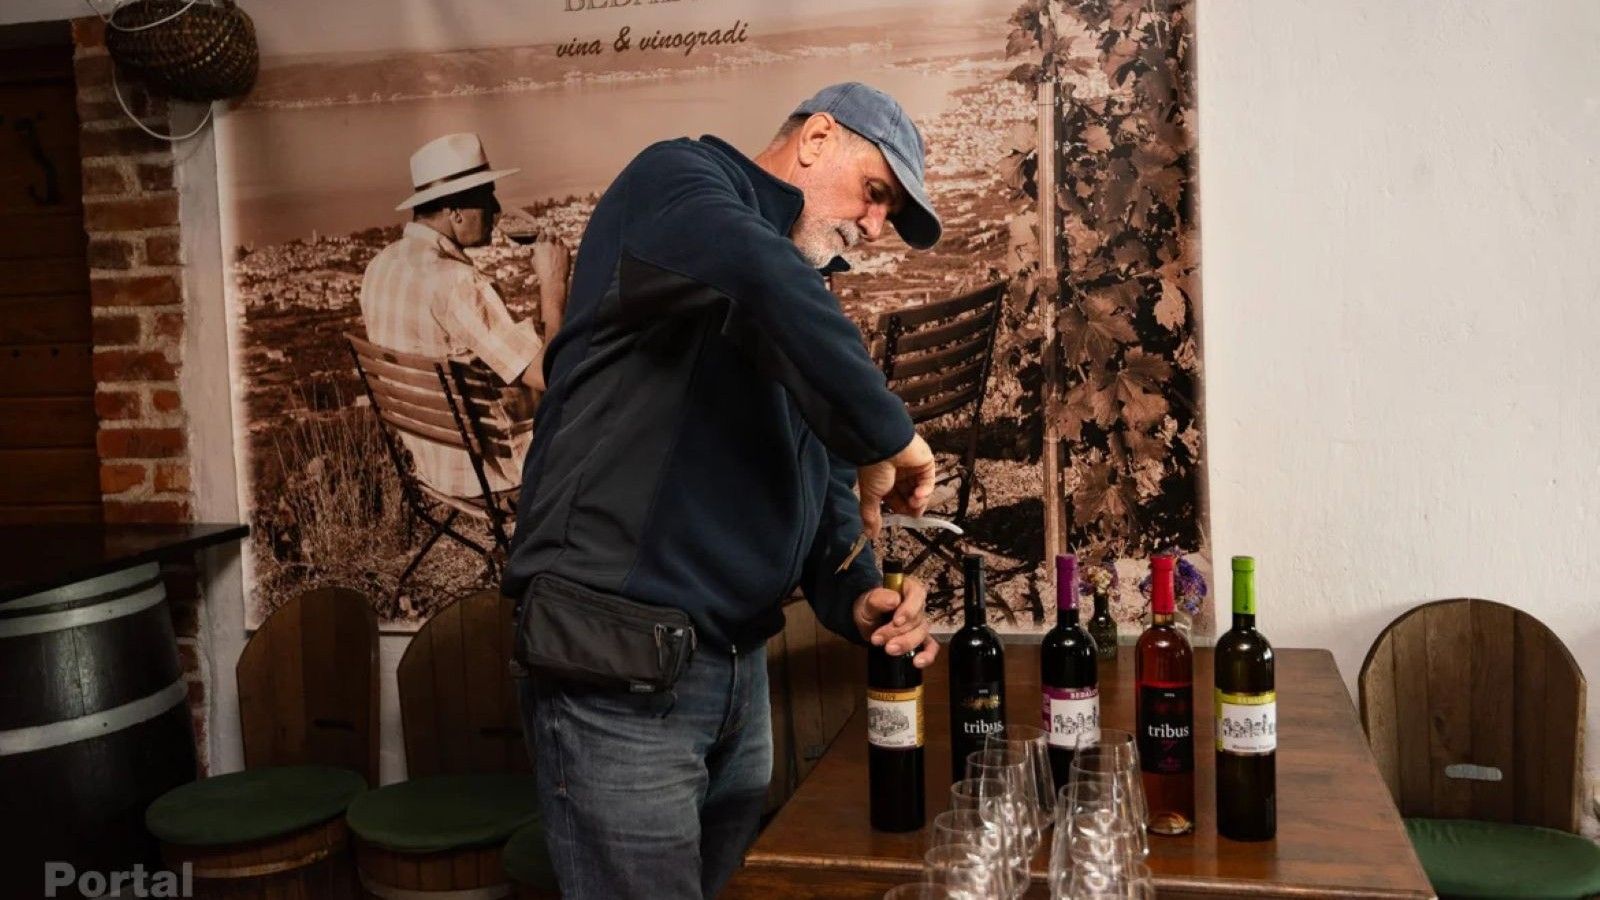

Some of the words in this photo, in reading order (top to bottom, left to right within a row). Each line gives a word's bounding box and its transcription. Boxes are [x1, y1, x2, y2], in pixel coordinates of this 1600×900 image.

[556, 37, 603, 58] vina
[613, 26, 631, 52] &
[640, 20, 749, 56] vinogradi
[964, 719, 1005, 734] tribus
[1148, 723, 1190, 738] tribus
